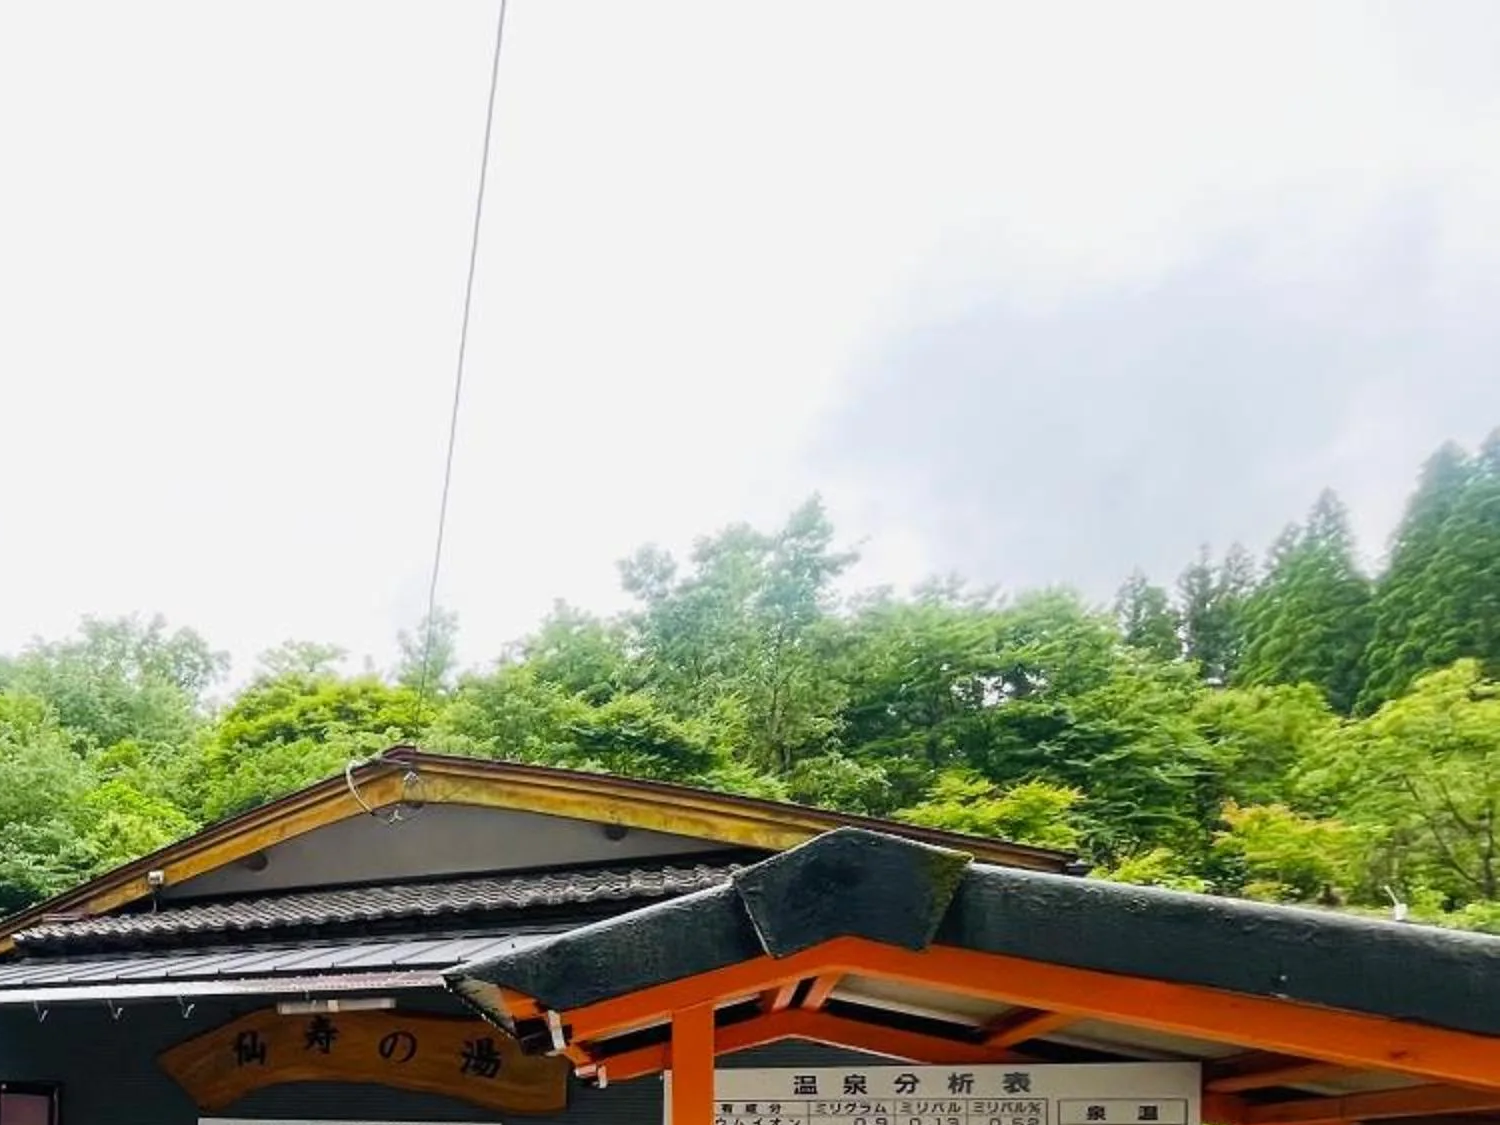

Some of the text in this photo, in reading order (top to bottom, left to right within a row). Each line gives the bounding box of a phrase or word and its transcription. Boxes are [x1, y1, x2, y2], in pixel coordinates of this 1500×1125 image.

[233, 1015, 501, 1079] 仙寿の湯
[793, 1072, 1031, 1095] 温泉分析表
[816, 1103, 886, 1115] ミリグラム
[901, 1102, 961, 1113] ミリバル
[1087, 1106, 1158, 1121] 泉温
